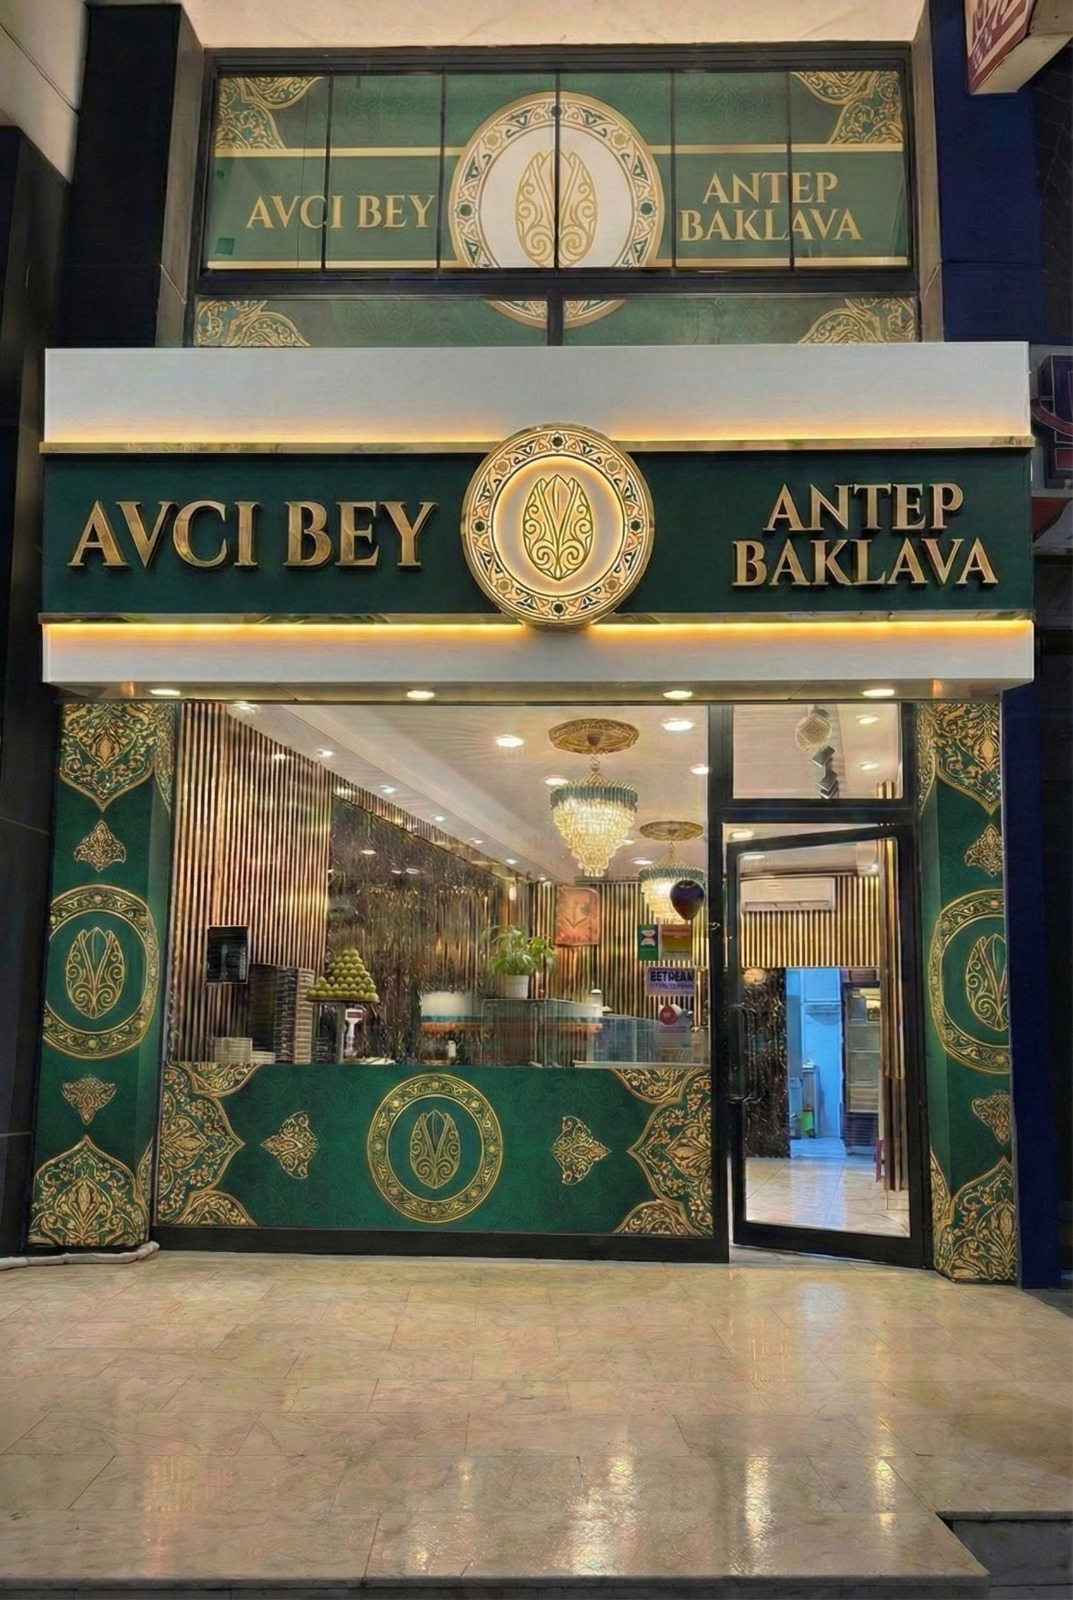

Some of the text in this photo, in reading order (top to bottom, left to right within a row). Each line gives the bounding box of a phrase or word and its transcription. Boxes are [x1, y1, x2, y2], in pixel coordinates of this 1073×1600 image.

[702, 171, 838, 204] ANTEP
[245, 195, 435, 229] AVCI BEY
[679, 208, 864, 241] BAKLAVA
[763, 483, 965, 532] ANTEP
[67, 500, 439, 571] AVCI BEY
[732, 537, 998, 587] BAKLAVA
